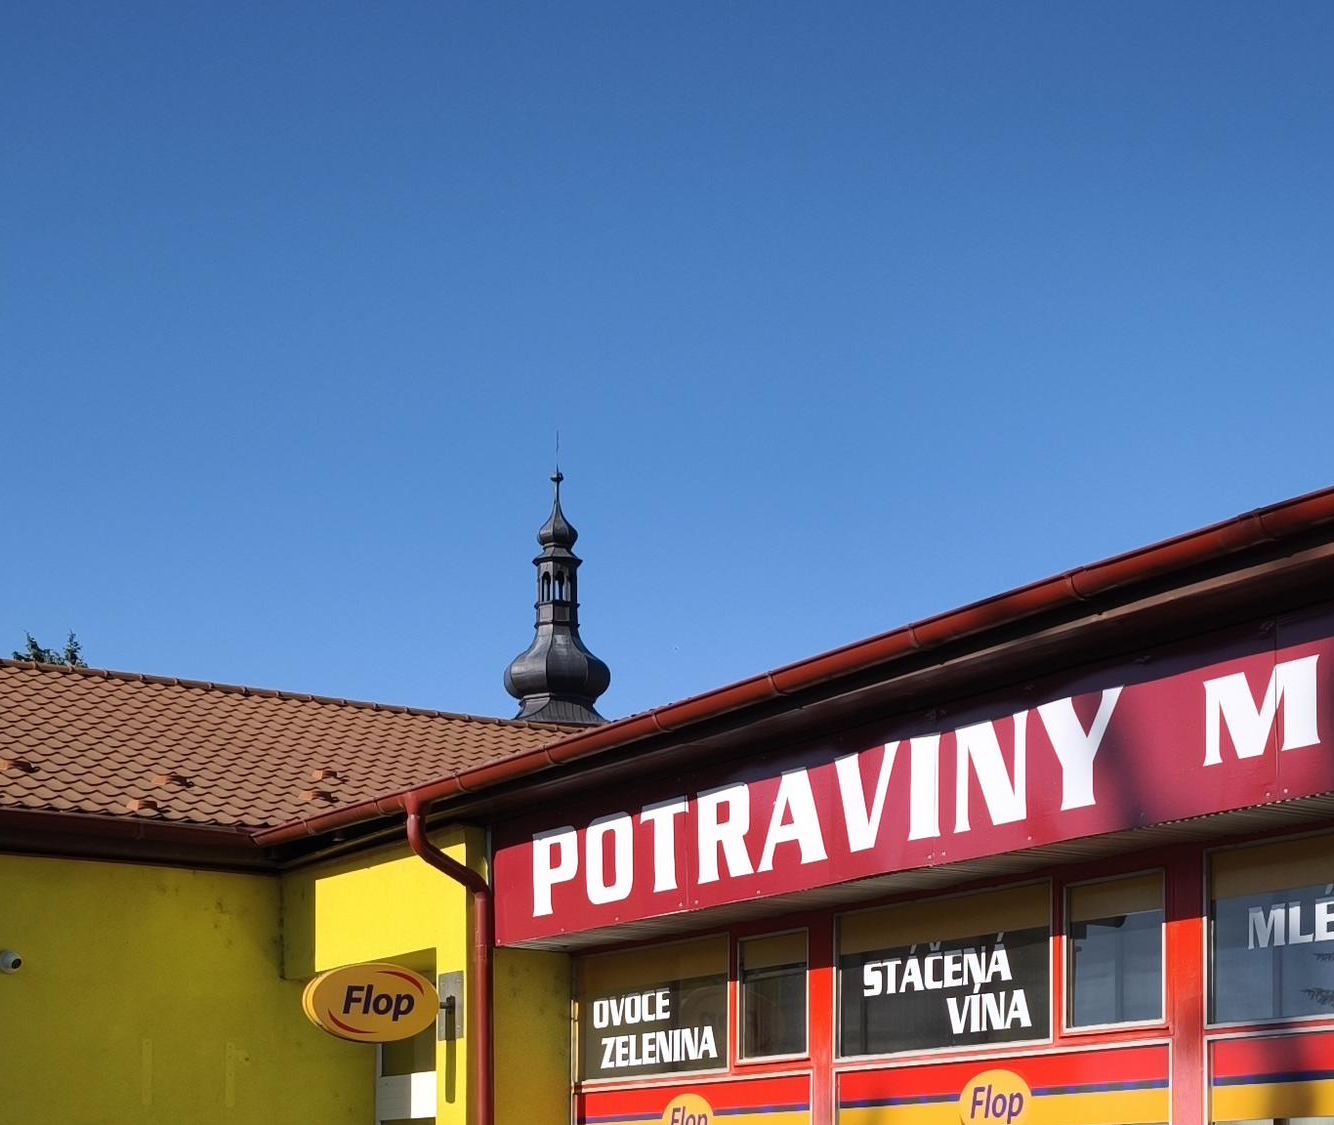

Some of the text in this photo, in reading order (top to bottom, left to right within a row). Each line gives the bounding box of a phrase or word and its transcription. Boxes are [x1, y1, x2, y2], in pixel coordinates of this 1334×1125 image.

[533, 686, 1124, 918] POTRAVINY
[864, 932, 1013, 997] STÁČENÁ
[342, 984, 414, 1021] Flop
[593, 988, 671, 1029] OVOCE
[946, 982, 1032, 1035] VÍNA
[601, 1026, 718, 1070] ZELENINA
[970, 1085, 1024, 1125] Flop
